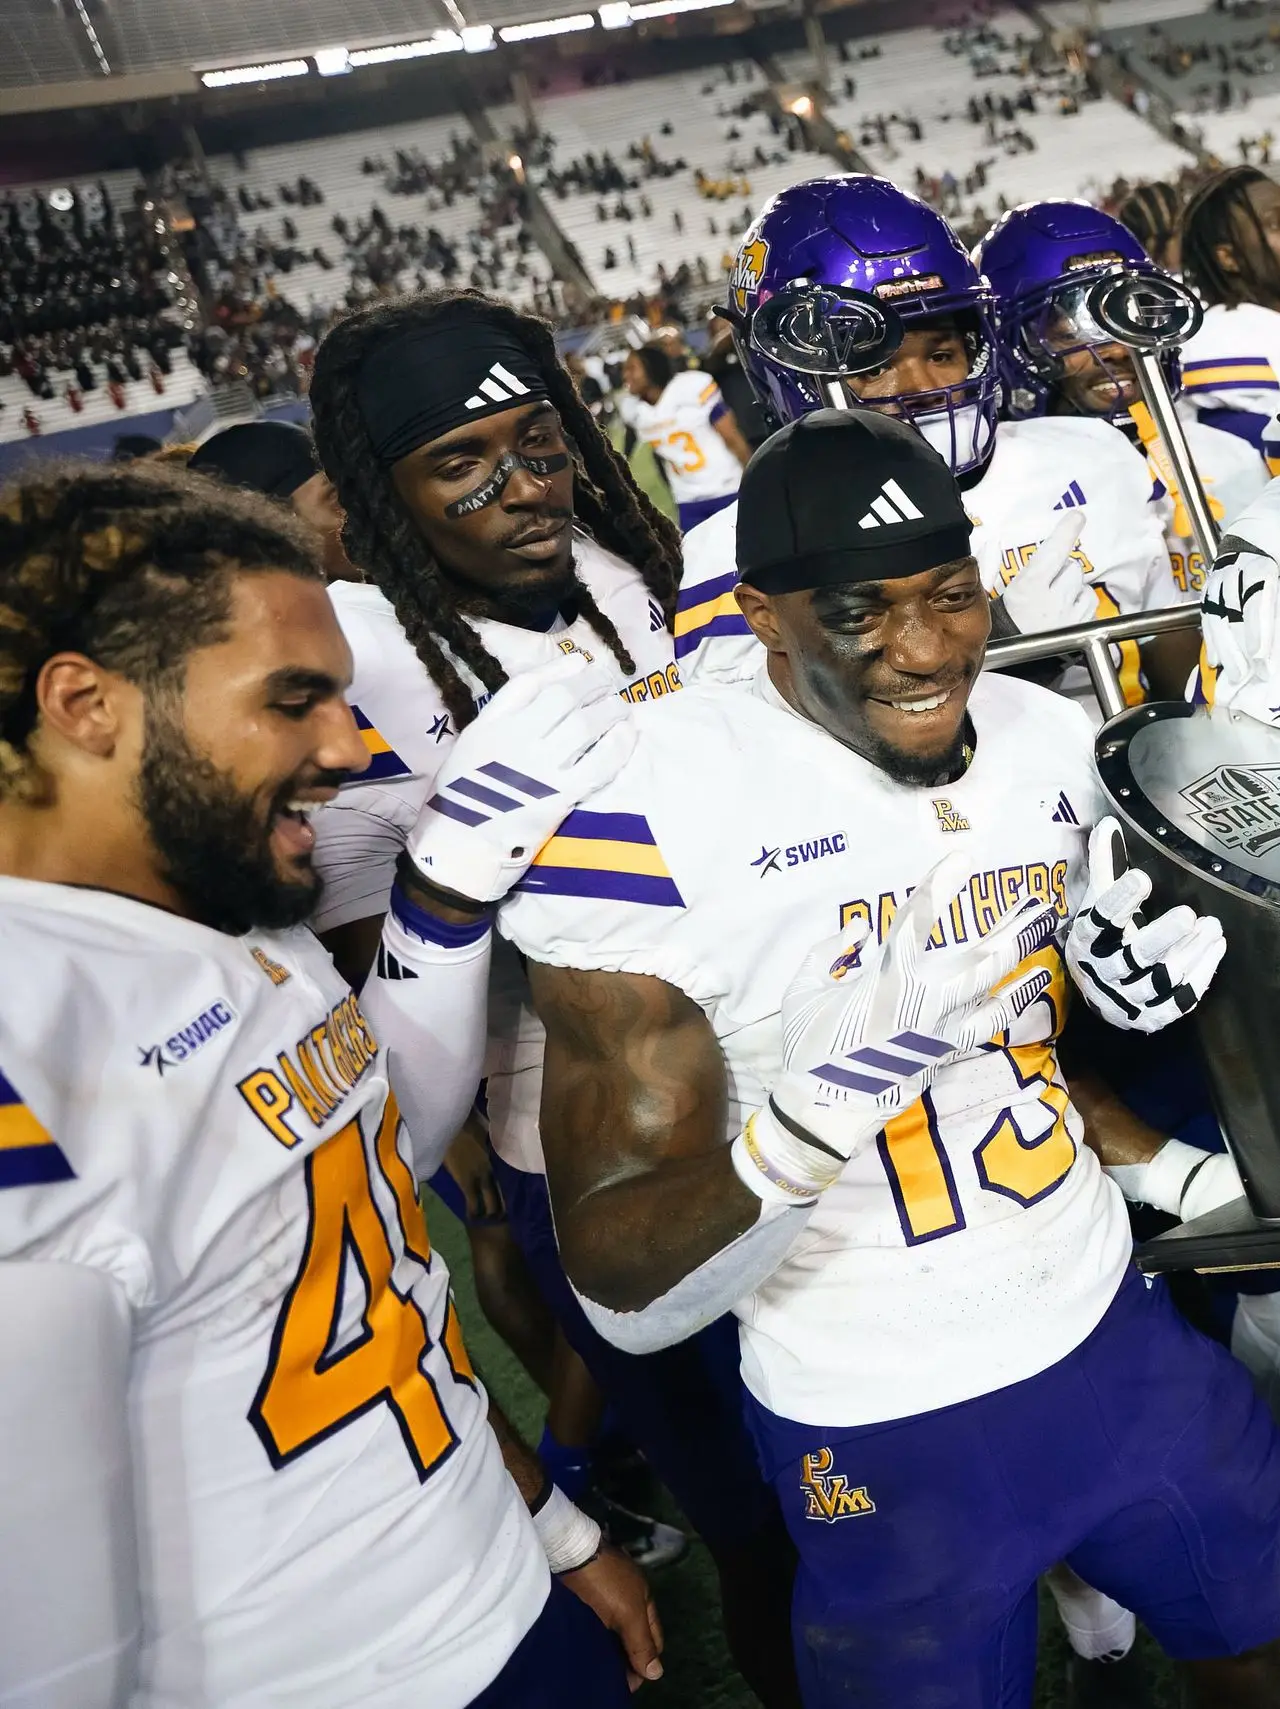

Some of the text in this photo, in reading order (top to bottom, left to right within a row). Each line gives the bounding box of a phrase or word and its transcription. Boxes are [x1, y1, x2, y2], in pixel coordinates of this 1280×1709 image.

[785, 833, 847, 867] SWAC
[166, 1002, 232, 1060] SWAC
[235, 987, 378, 1150] PANTHERS
